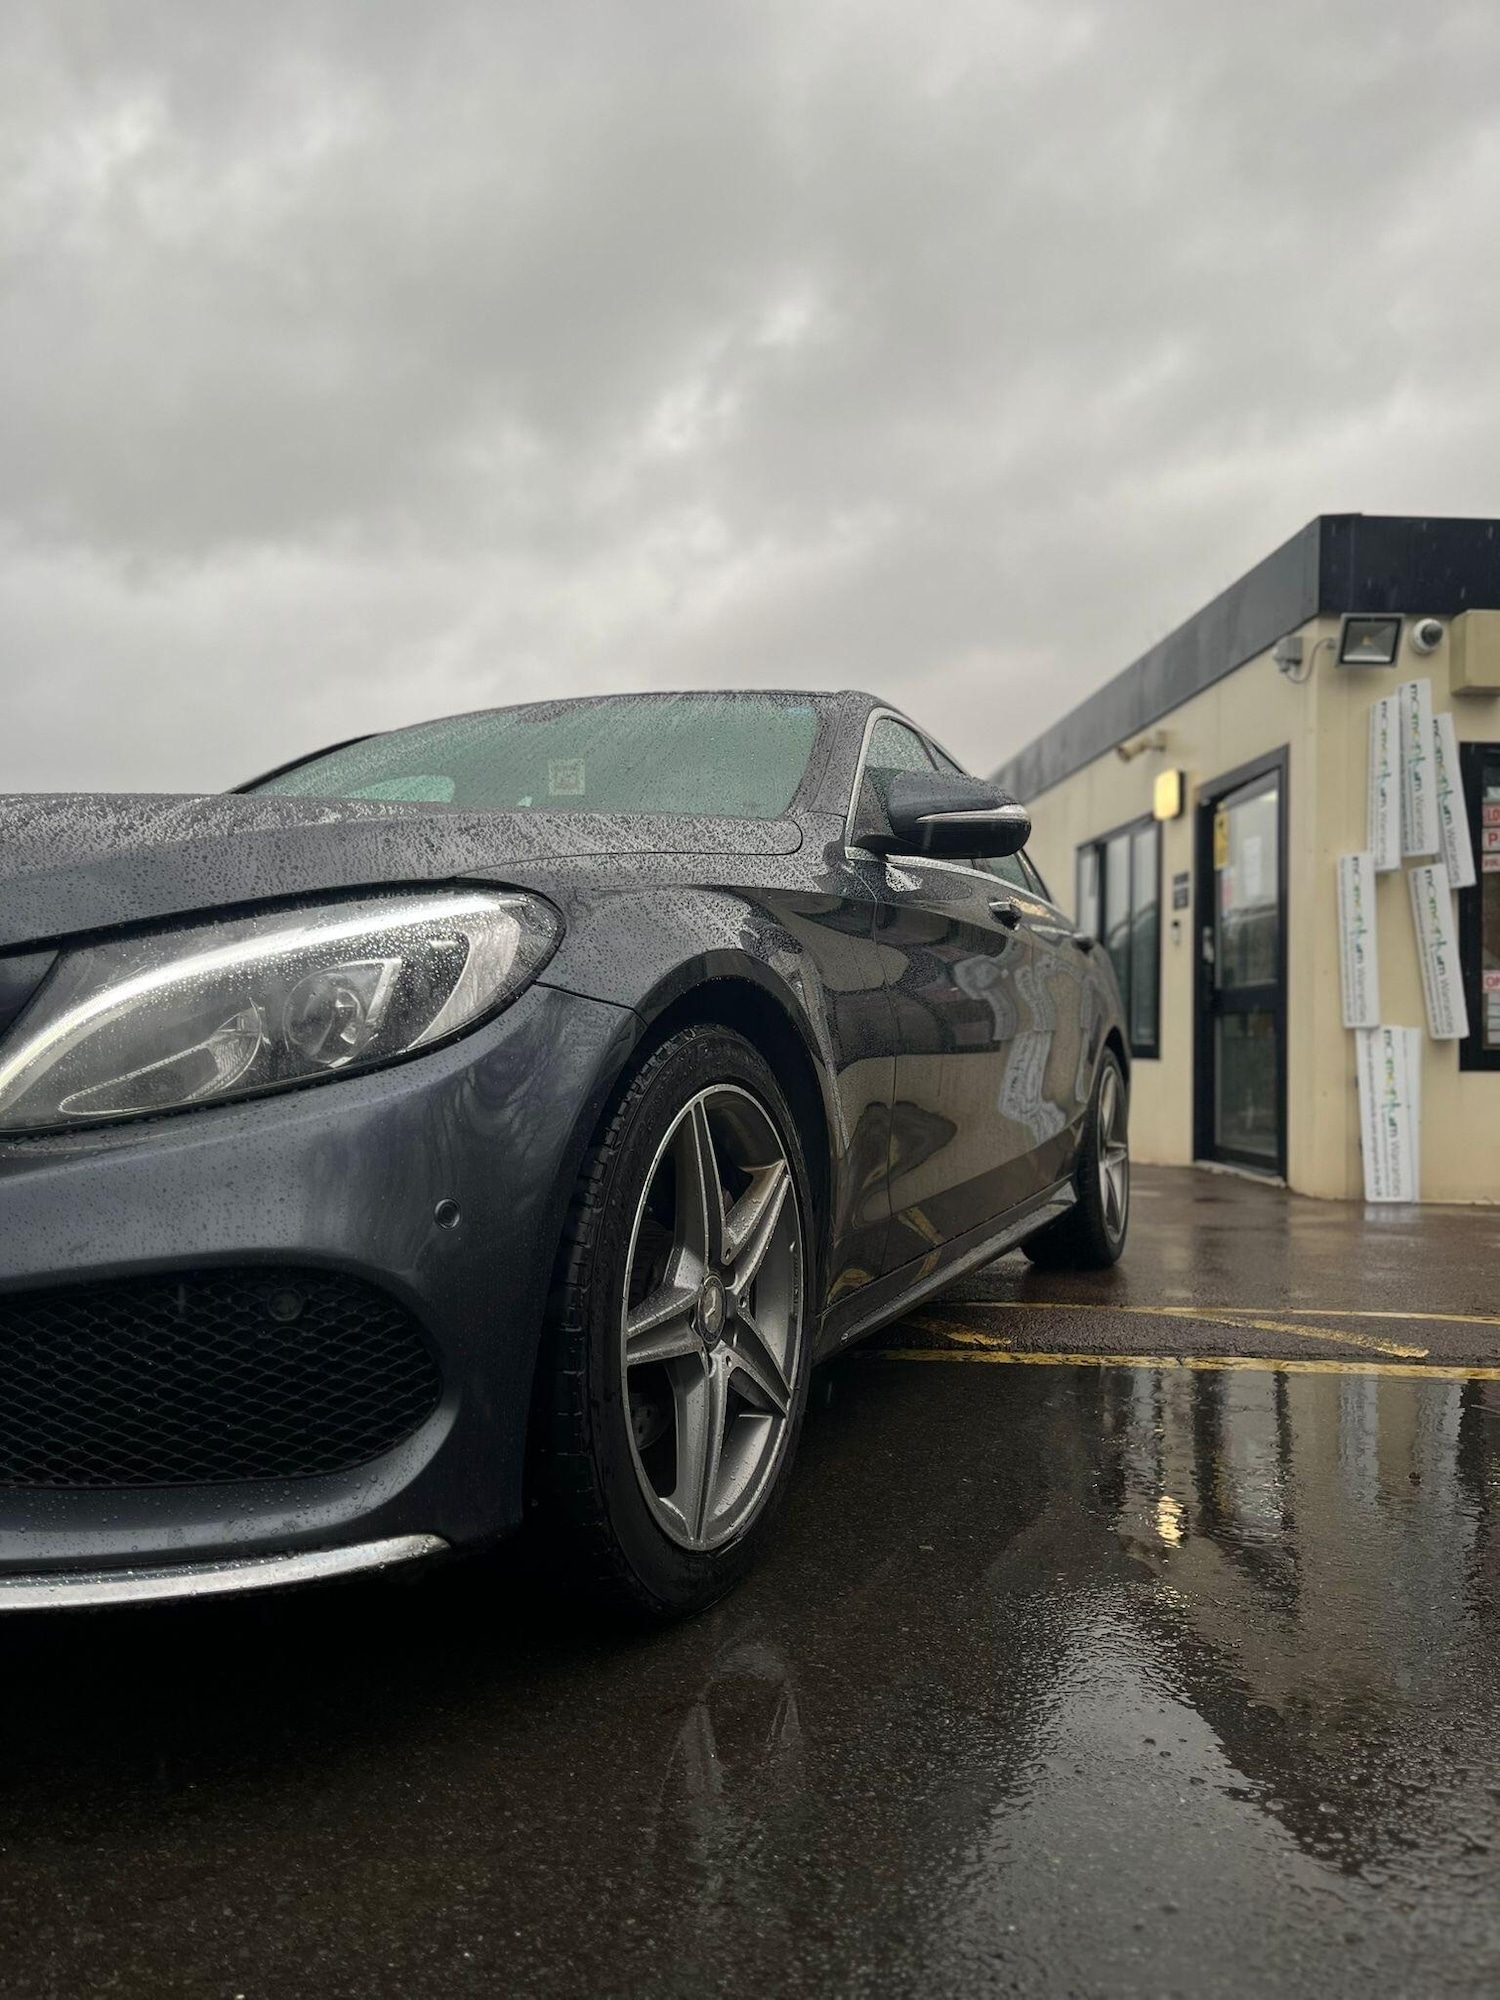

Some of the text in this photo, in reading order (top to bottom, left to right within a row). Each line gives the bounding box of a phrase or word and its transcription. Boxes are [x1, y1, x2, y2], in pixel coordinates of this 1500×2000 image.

[1407, 683, 1426, 792] momentum
[1350, 856, 1368, 965] momentum
[1424, 868, 1447, 976] momentum
[1381, 1029, 1401, 1138] momentum
